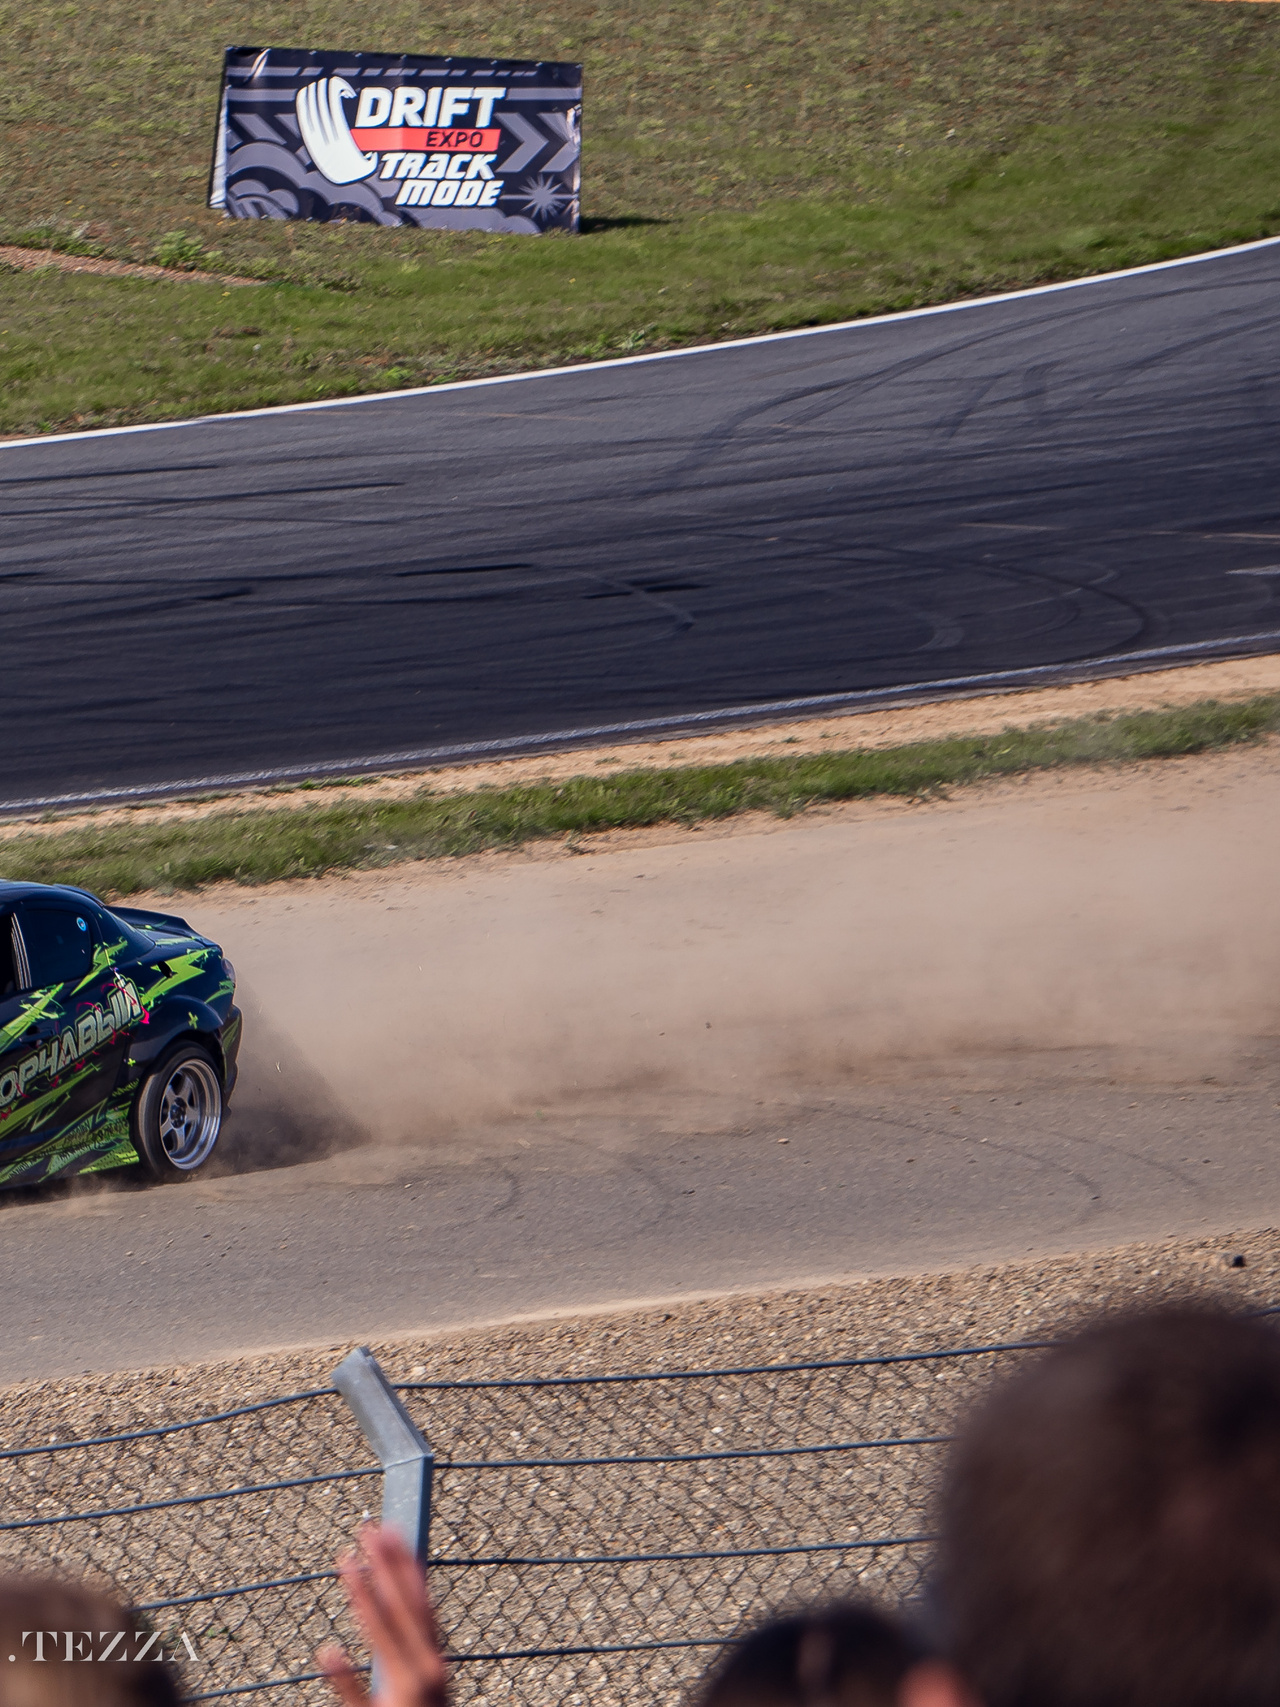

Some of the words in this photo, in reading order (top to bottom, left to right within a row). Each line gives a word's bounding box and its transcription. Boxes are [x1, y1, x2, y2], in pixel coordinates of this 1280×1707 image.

[354, 86, 506, 128] DRIFT
[425, 130, 484, 148] EXPO
[380, 152, 498, 180] TRACK
[395, 180, 505, 207] MODE
